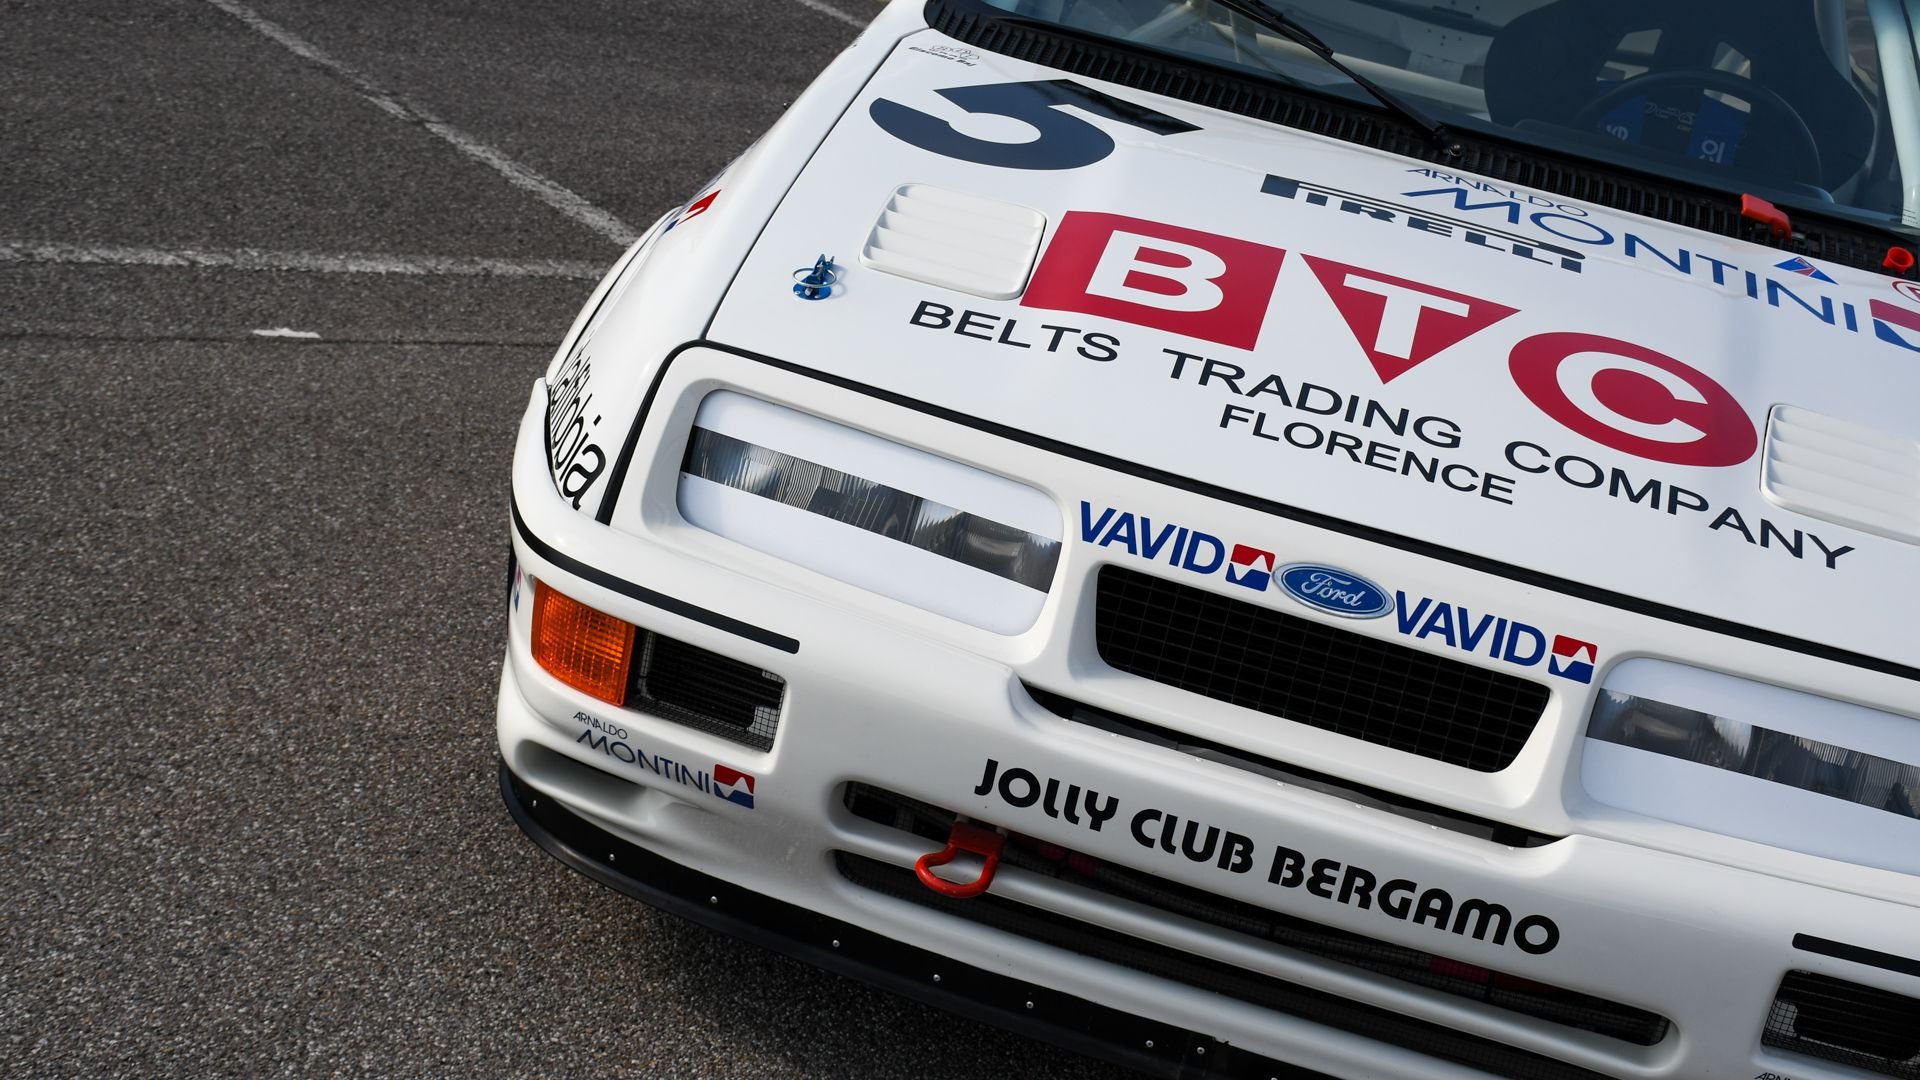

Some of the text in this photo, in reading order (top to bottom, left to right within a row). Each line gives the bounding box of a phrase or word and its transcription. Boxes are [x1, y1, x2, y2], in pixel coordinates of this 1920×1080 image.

[869, 79, 1204, 170] 5
[1260, 174, 1586, 274] PIRELLI
[1405, 168, 1589, 217] ARNALDO
[1400, 187, 1858, 333] MONTINI
[910, 301, 1855, 570] BELTS TRADING COMPANY
[1219, 404, 1516, 505] FLORENCE
[1081, 500, 1226, 575] VAVID
[1301, 572, 1366, 607] Ford
[1396, 590, 1546, 667] VAVID
[573, 711, 628, 740] ARNALDO
[576, 729, 710, 794] MONTINI
[974, 759, 1560, 955] JOLLY CLUB BERGAMO
